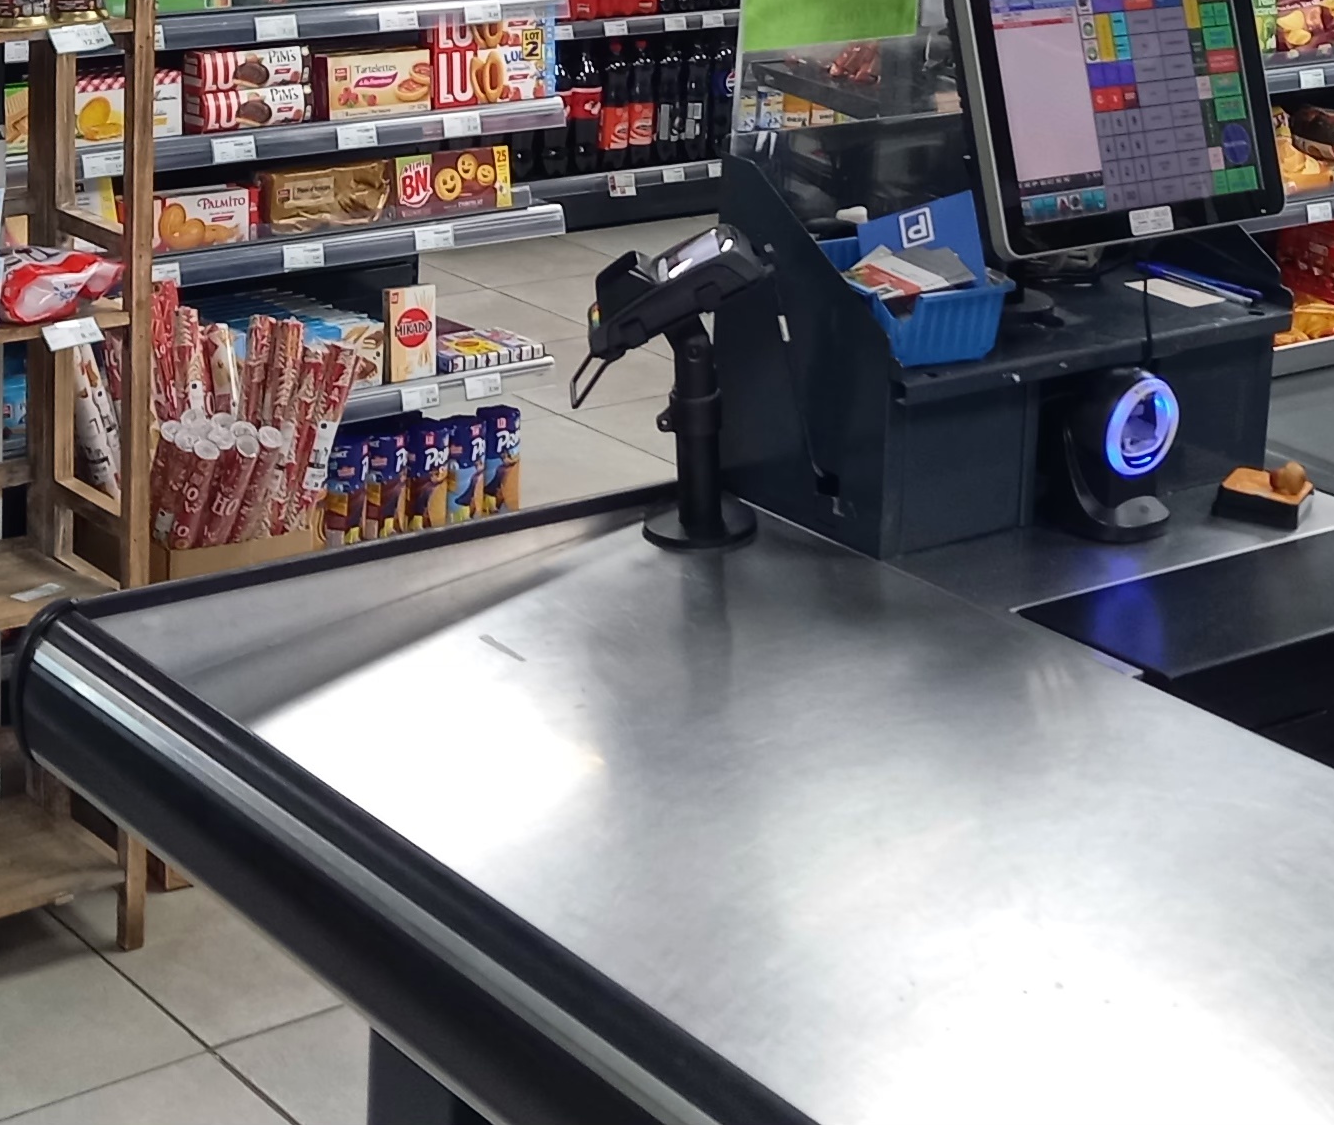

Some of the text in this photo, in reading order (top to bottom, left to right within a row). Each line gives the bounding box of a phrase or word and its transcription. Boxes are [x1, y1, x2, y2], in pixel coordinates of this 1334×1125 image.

[525, 32, 541, 42] LOT
[268, 49, 297, 64] PiM's
[525, 41, 541, 58] 2
[204, 51, 237, 92] LU
[353, 62, 397, 75] Tartelettes
[439, 51, 474, 105] LU
[269, 86, 299, 102] PiM's
[205, 92, 240, 130] LU
[496, 149, 508, 163] 25
[400, 168, 432, 200] BN
[197, 194, 246, 210] PALMITO
[394, 318, 434, 336] MIKADO
